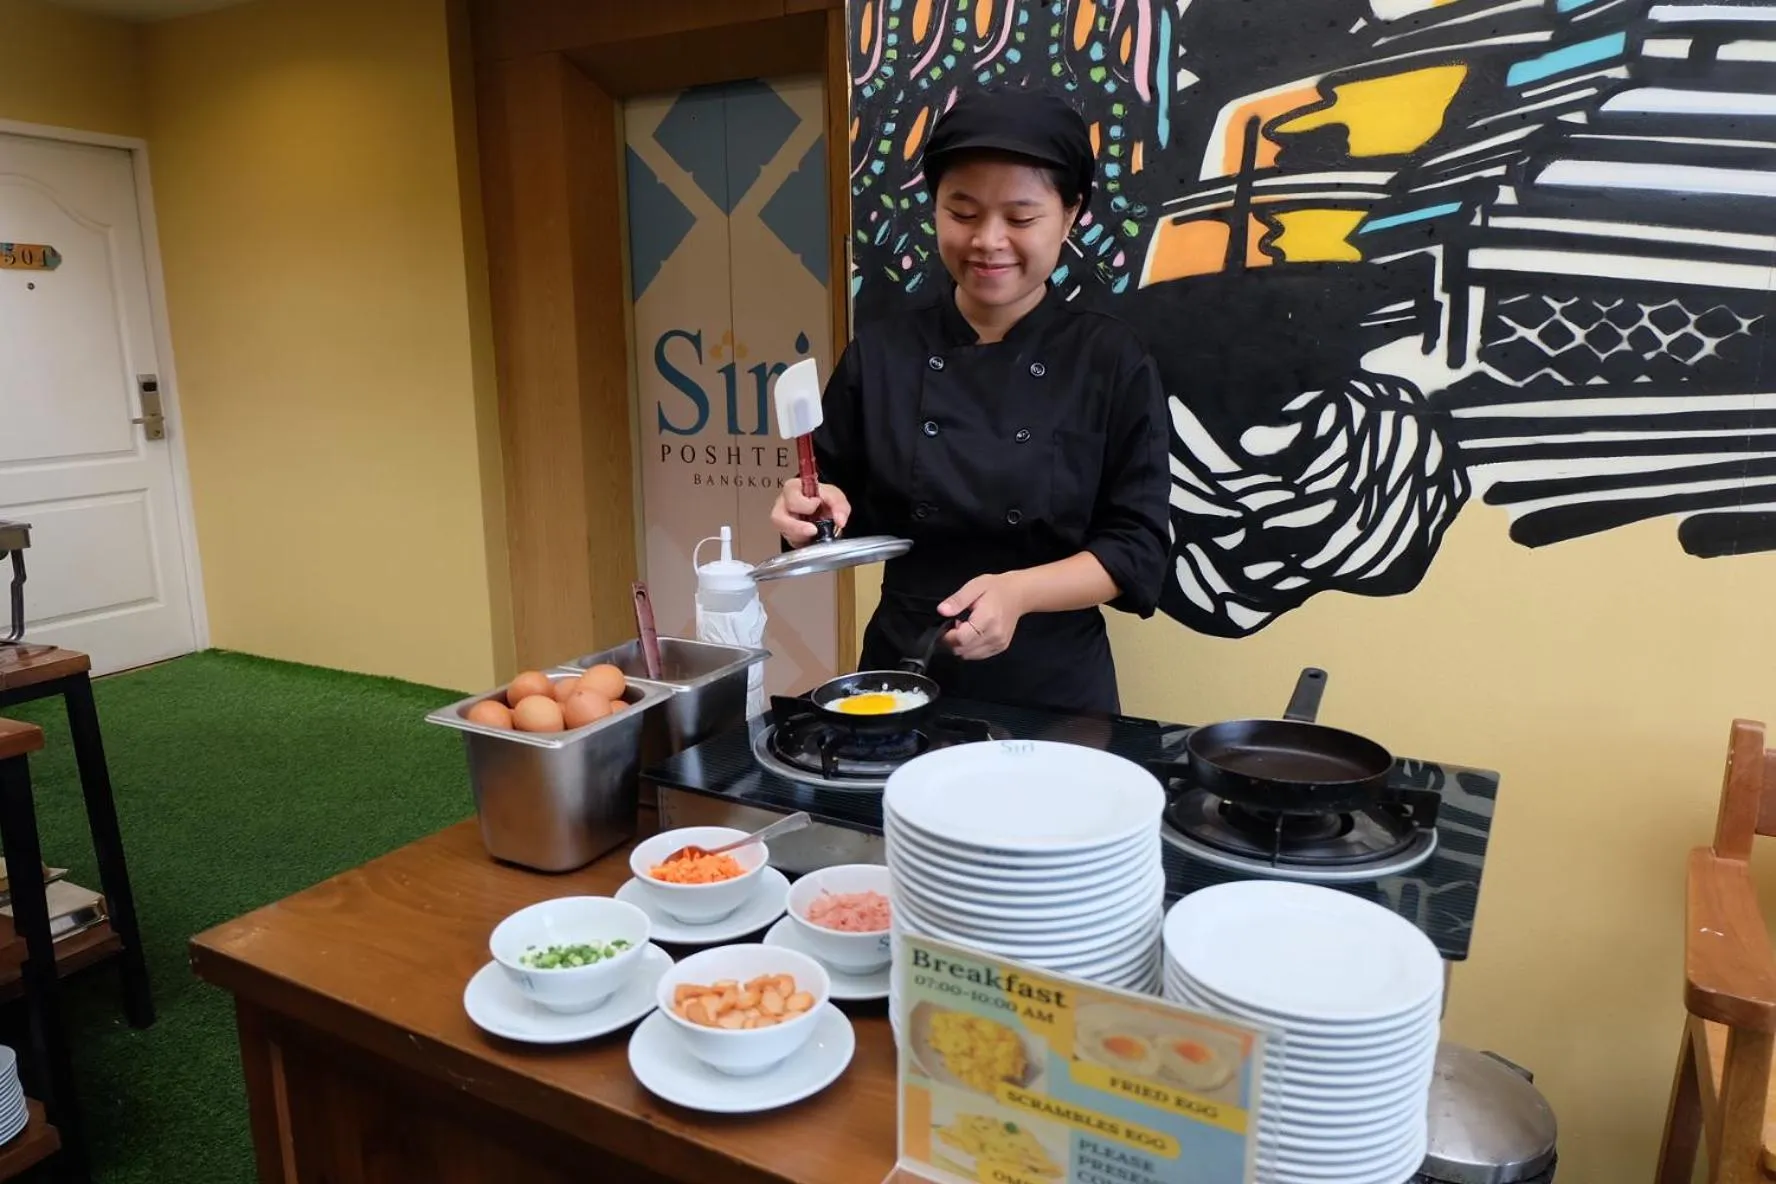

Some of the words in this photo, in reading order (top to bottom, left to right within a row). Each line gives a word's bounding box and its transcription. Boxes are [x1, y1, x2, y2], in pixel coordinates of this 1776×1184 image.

[654, 329, 810, 436] Sir
[660, 443, 789, 468] POSHTE
[693, 473, 786, 489] BANGKOK
[912, 947, 1068, 1009] Breakfast
[914, 974, 1018, 1013] 07:00-10:00
[1022, 1006, 1055, 1025] AM
[1006, 1090, 1120, 1136] SCRAMBLES
[1124, 1127, 1168, 1151] EGG
[1109, 1076, 1170, 1103] FRIED
[1174, 1095, 1219, 1119] EGG
[1078, 1137, 1155, 1174] PLEASE
